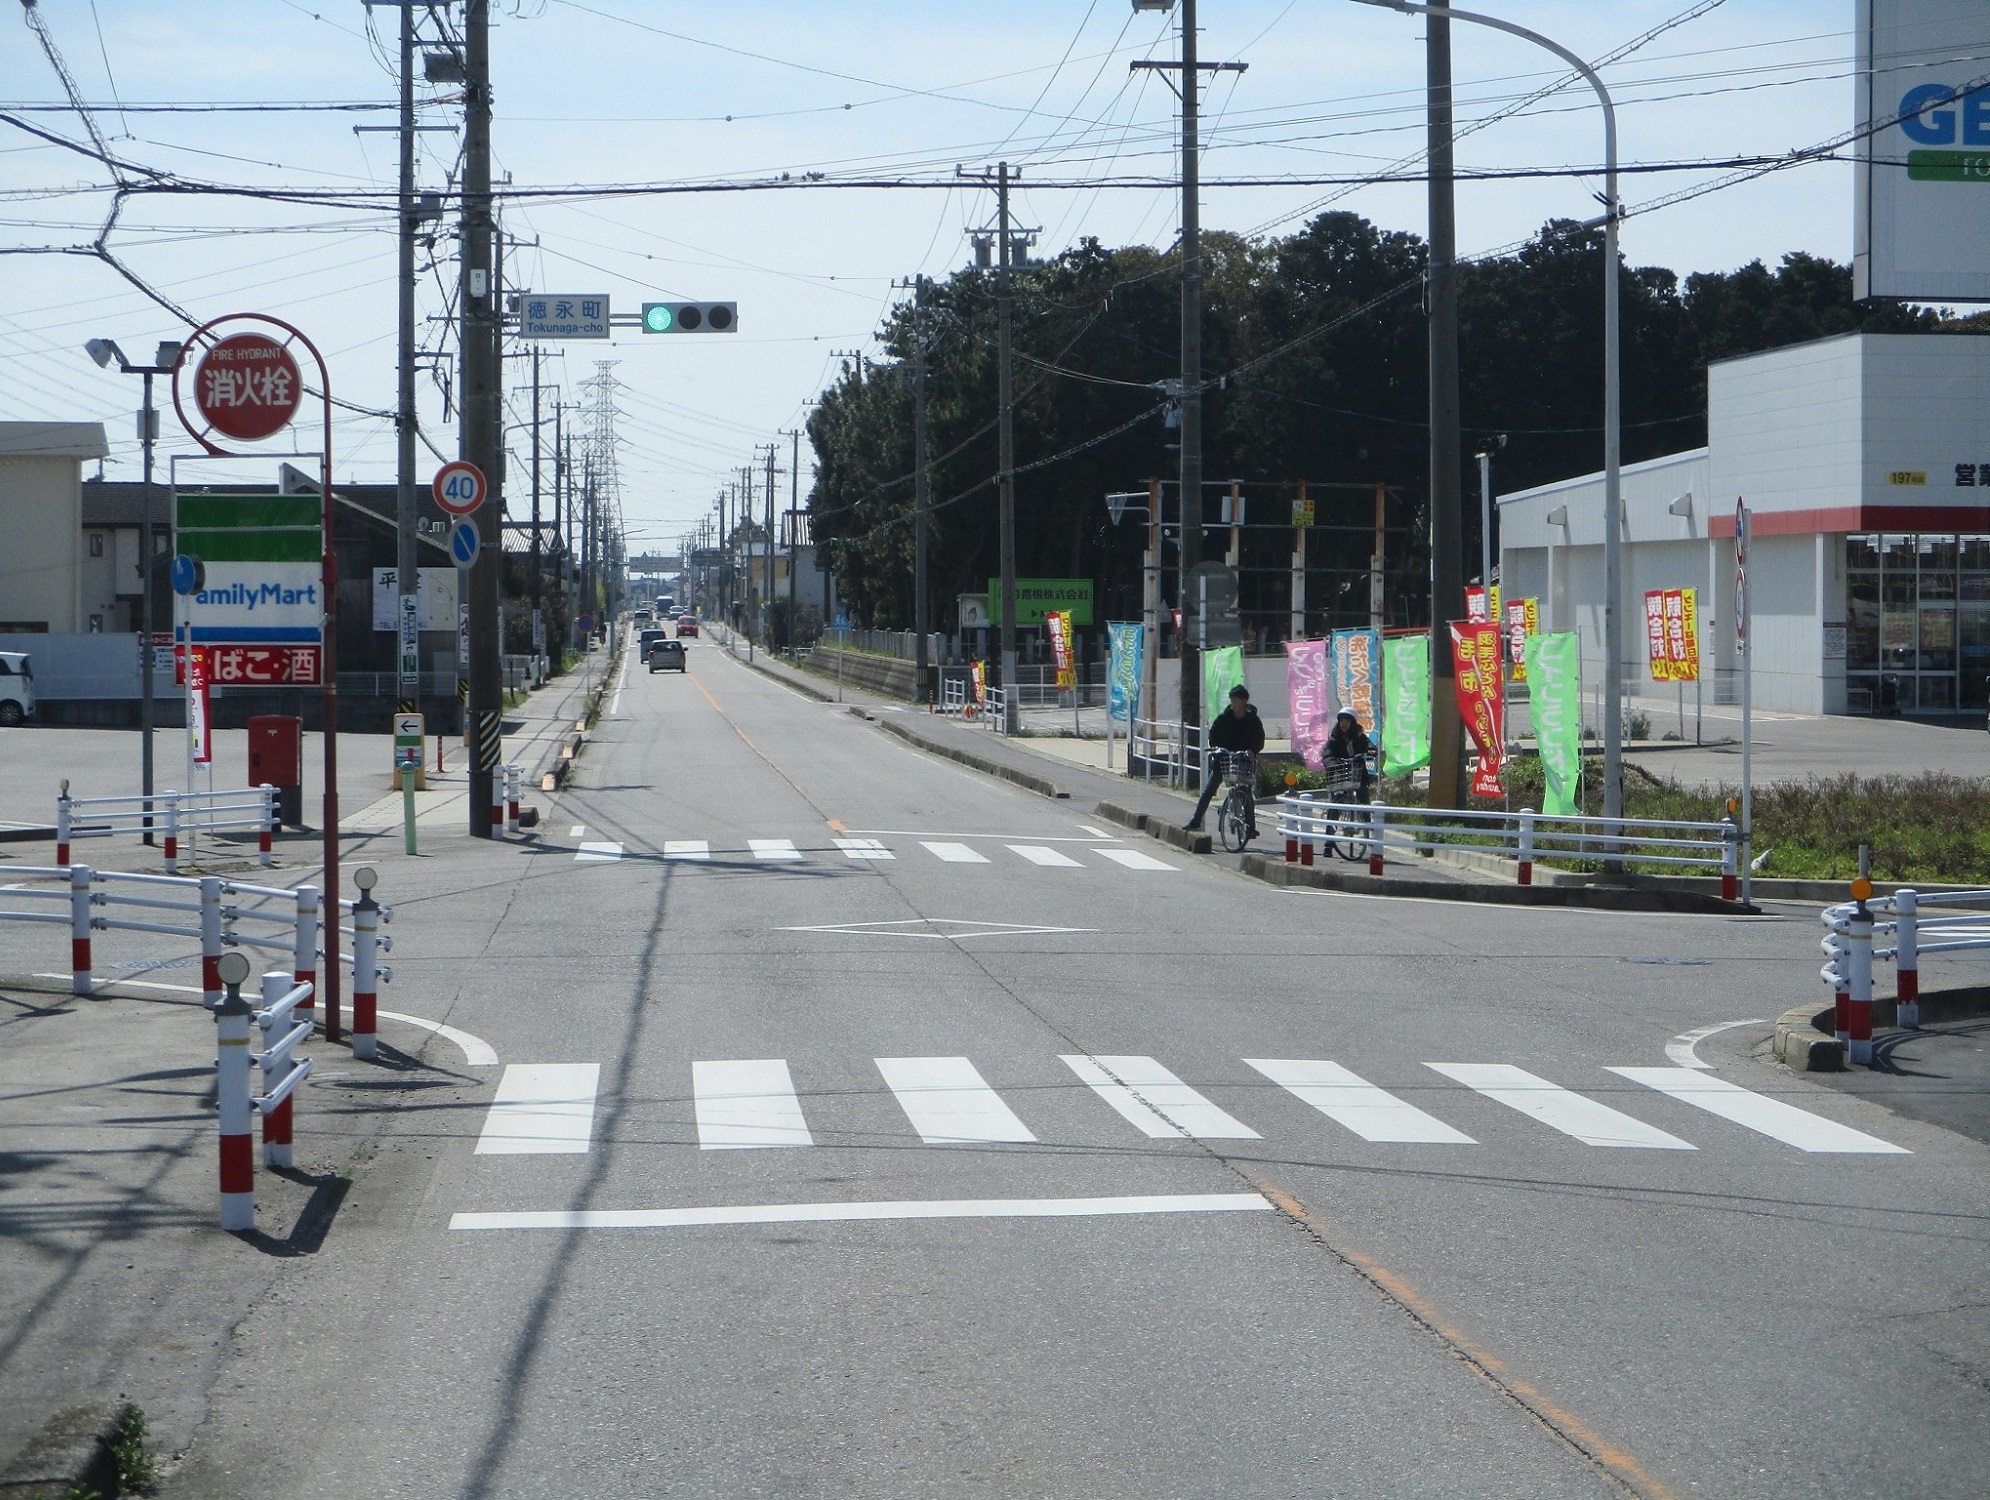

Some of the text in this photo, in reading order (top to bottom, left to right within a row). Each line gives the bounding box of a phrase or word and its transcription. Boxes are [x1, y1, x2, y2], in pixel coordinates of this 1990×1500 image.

[528, 301, 601, 320] 徳永町
[527, 322, 603, 334] Tokunaga-cho
[212, 347, 281, 361] FIRE HYDRANT
[205, 366, 293, 408] 消火栓
[445, 476, 474, 499] 40
[196, 583, 316, 610] amilyMart
[209, 648, 316, 683] ばこ・酒
